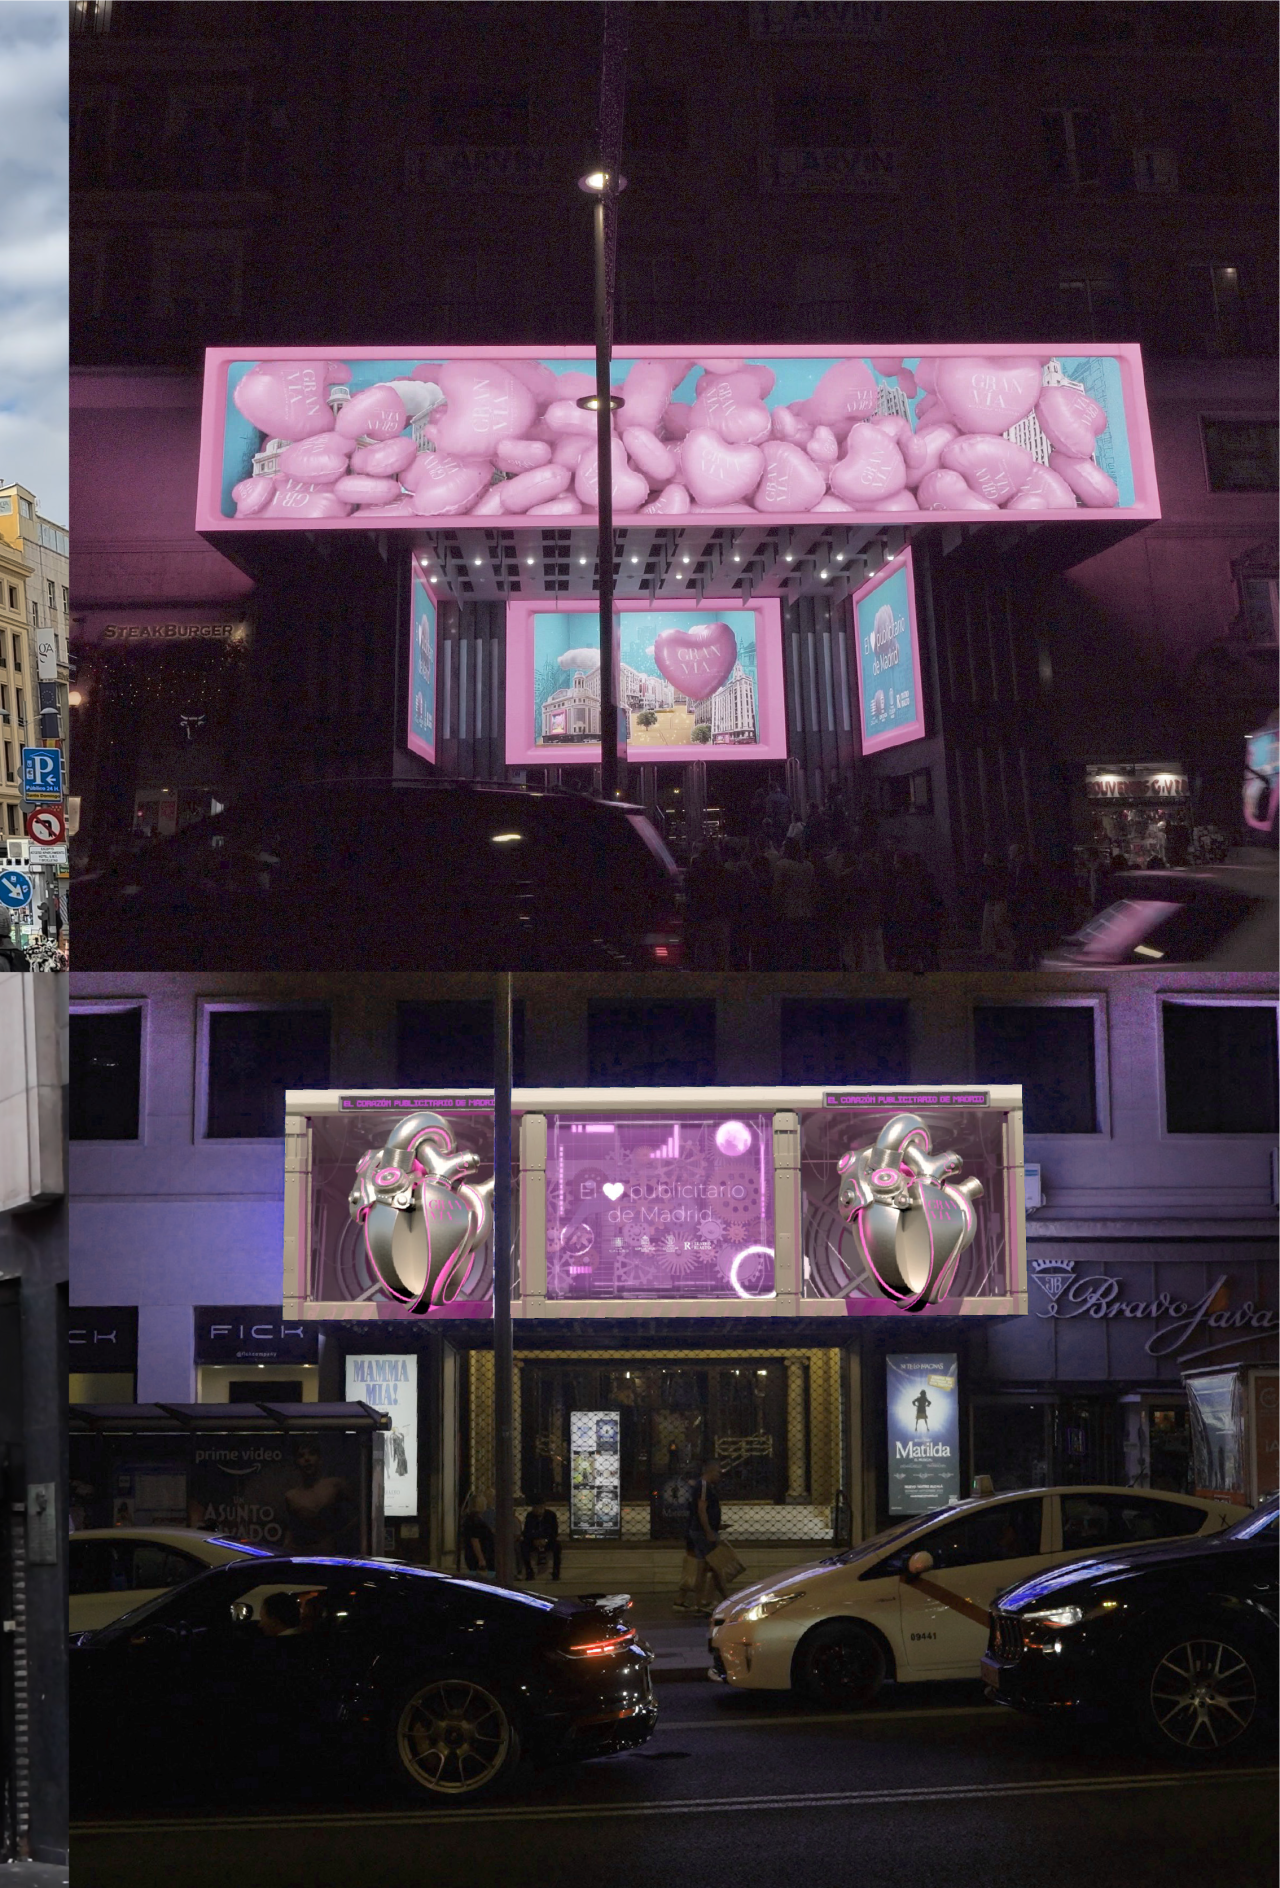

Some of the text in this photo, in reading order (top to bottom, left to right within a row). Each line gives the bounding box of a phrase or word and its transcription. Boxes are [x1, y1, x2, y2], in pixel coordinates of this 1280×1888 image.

[303, 369, 320, 416] GRAN
[972, 374, 1022, 395] GRAN
[472, 377, 490, 433] GRAN
[273, 490, 310, 507] GRA
[876, 614, 905, 648] publicitario
[678, 645, 721, 661] GRAN
[880, 646, 899, 673] Madrid
[33, 756, 54, 785] P
[357, 1098, 392, 1108] CORAZÓN
[840, 1095, 876, 1104] CORAZÓN
[878, 1096, 937, 1104] PUBLICITARIO
[580, 1182, 746, 1202] El publicitario
[429, 1200, 463, 1210] GRAN
[928, 1200, 957, 1210] GRAN
[608, 1206, 712, 1223] de Madrid
[684, 1242, 692, 1250] R
[1036, 1276, 1188, 1318] Bravo
[210, 1325, 304, 1339] FICK
[353, 1360, 409, 1382] MAMMA
[365, 1383, 398, 1406] MIA!
[196, 1447, 282, 1463] prime video
[896, 1441, 951, 1459] Matilda
[204, 1503, 274, 1522] ASUNTO
[911, 1632, 936, 1641] 09441
